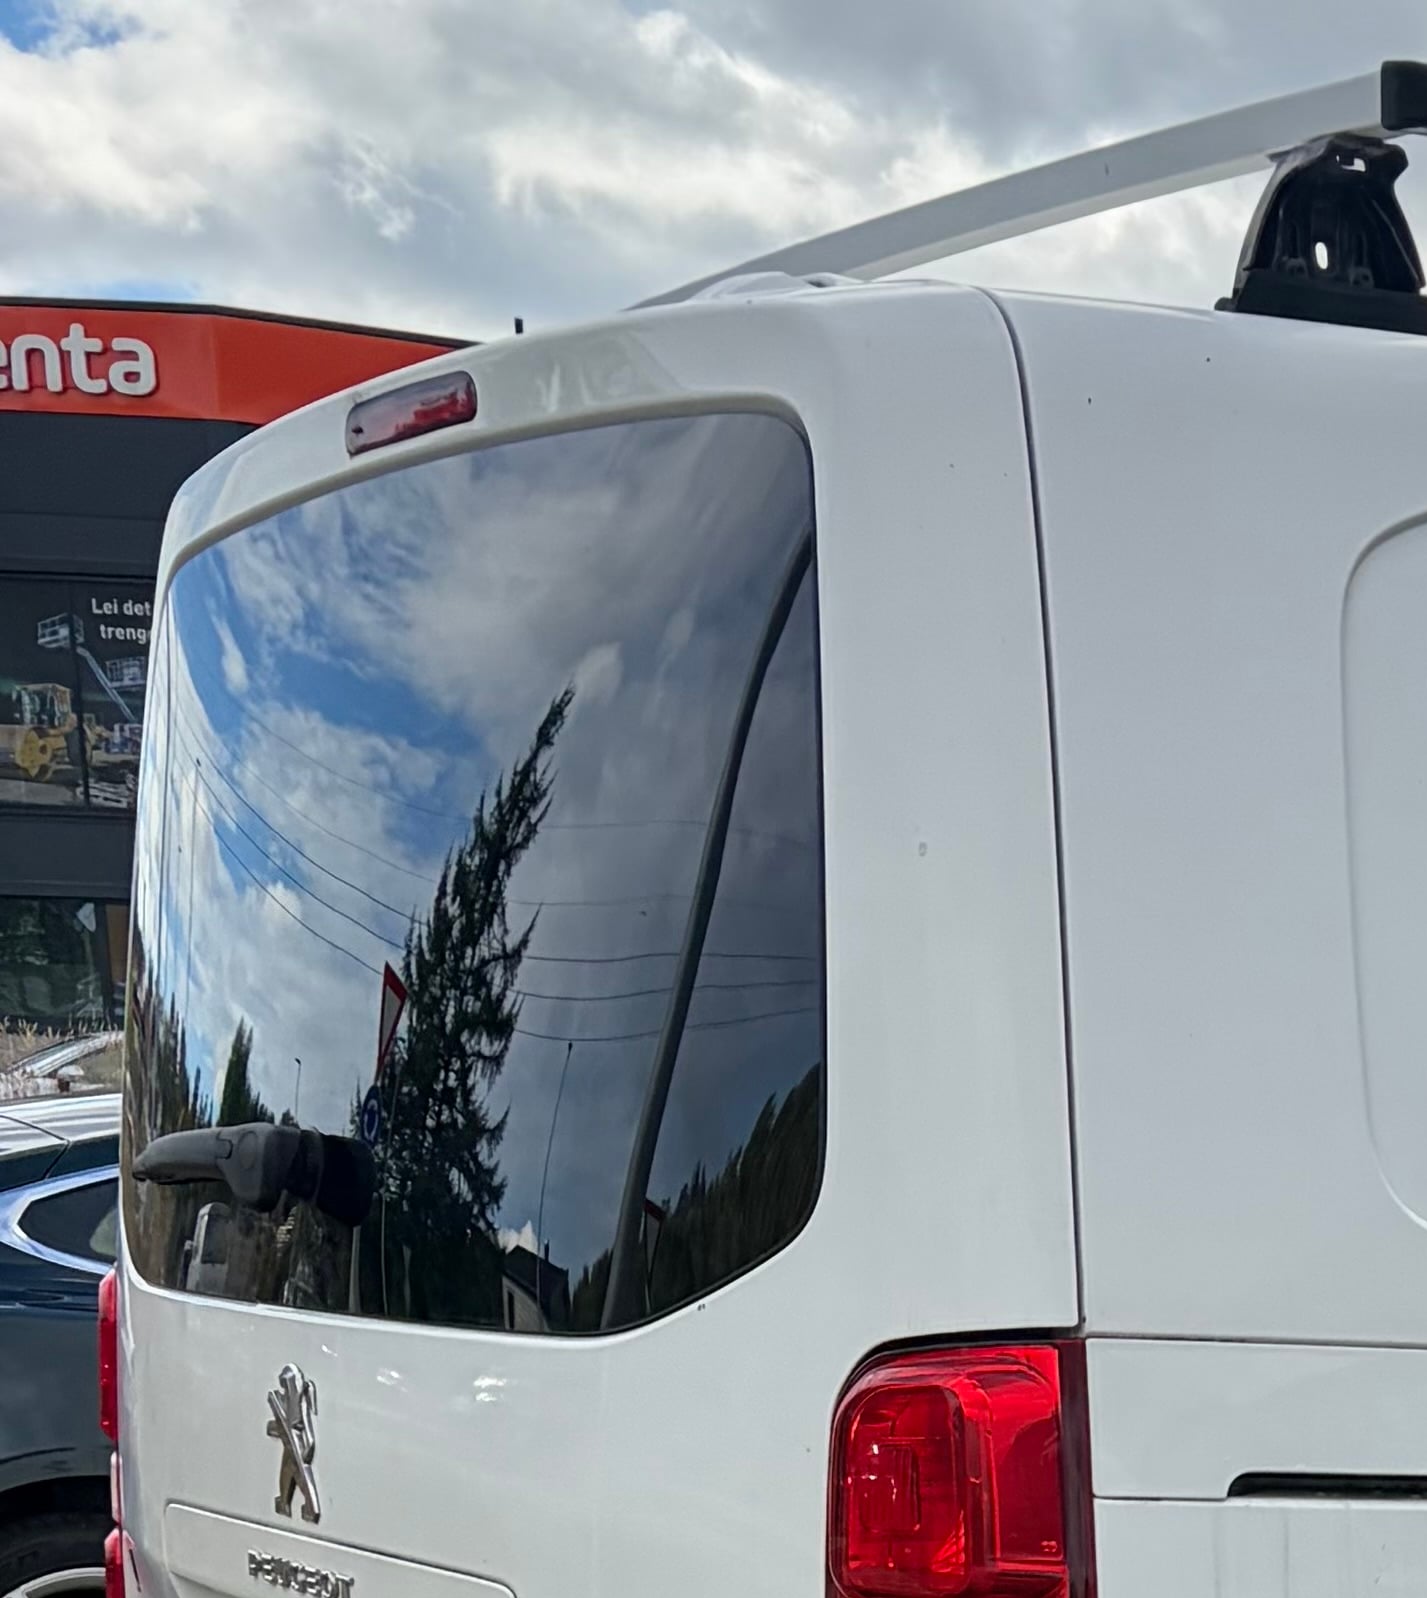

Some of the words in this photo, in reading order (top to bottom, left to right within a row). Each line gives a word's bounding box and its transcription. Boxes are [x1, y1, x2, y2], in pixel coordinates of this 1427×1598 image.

[0, 322, 157, 396] nta
[91, 597, 119, 615] Lei
[122, 599, 152, 616] det
